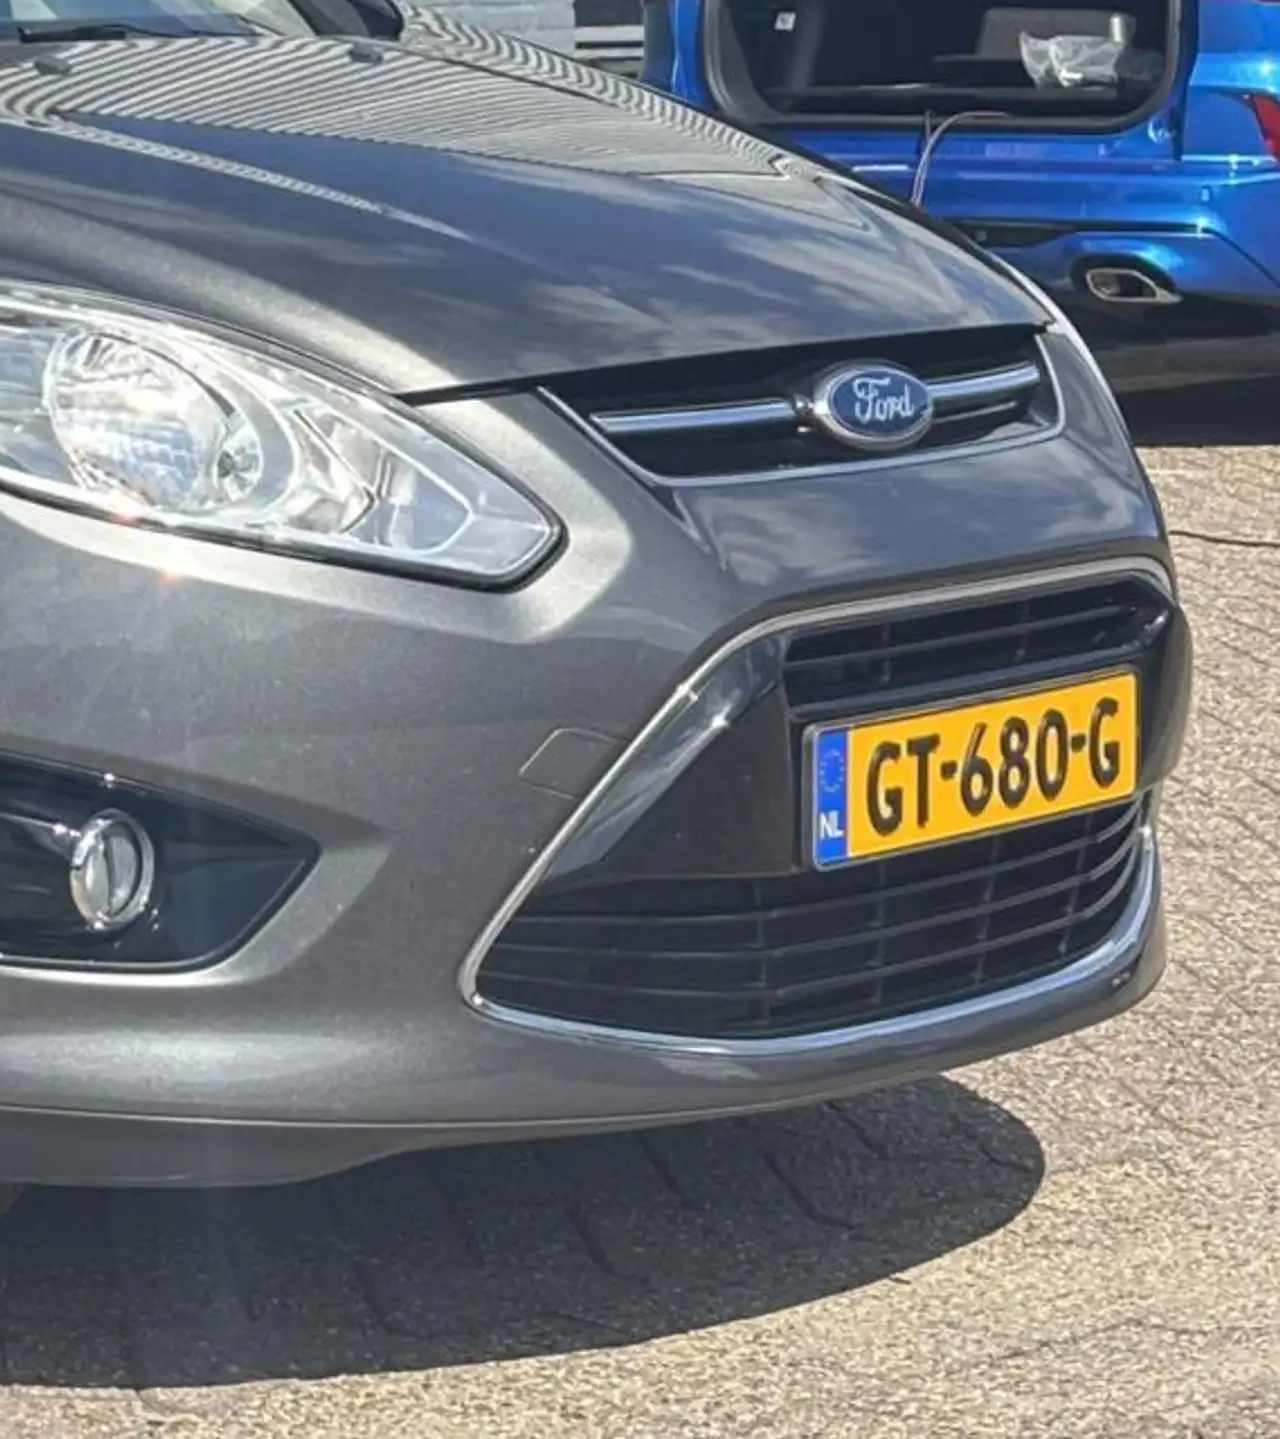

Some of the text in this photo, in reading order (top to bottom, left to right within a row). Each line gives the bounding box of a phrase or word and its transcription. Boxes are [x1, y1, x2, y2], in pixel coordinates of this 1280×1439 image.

[852, 377, 915, 424] Ford
[867, 697, 1120, 836] GT-680-G
[819, 811, 843, 839] NL
